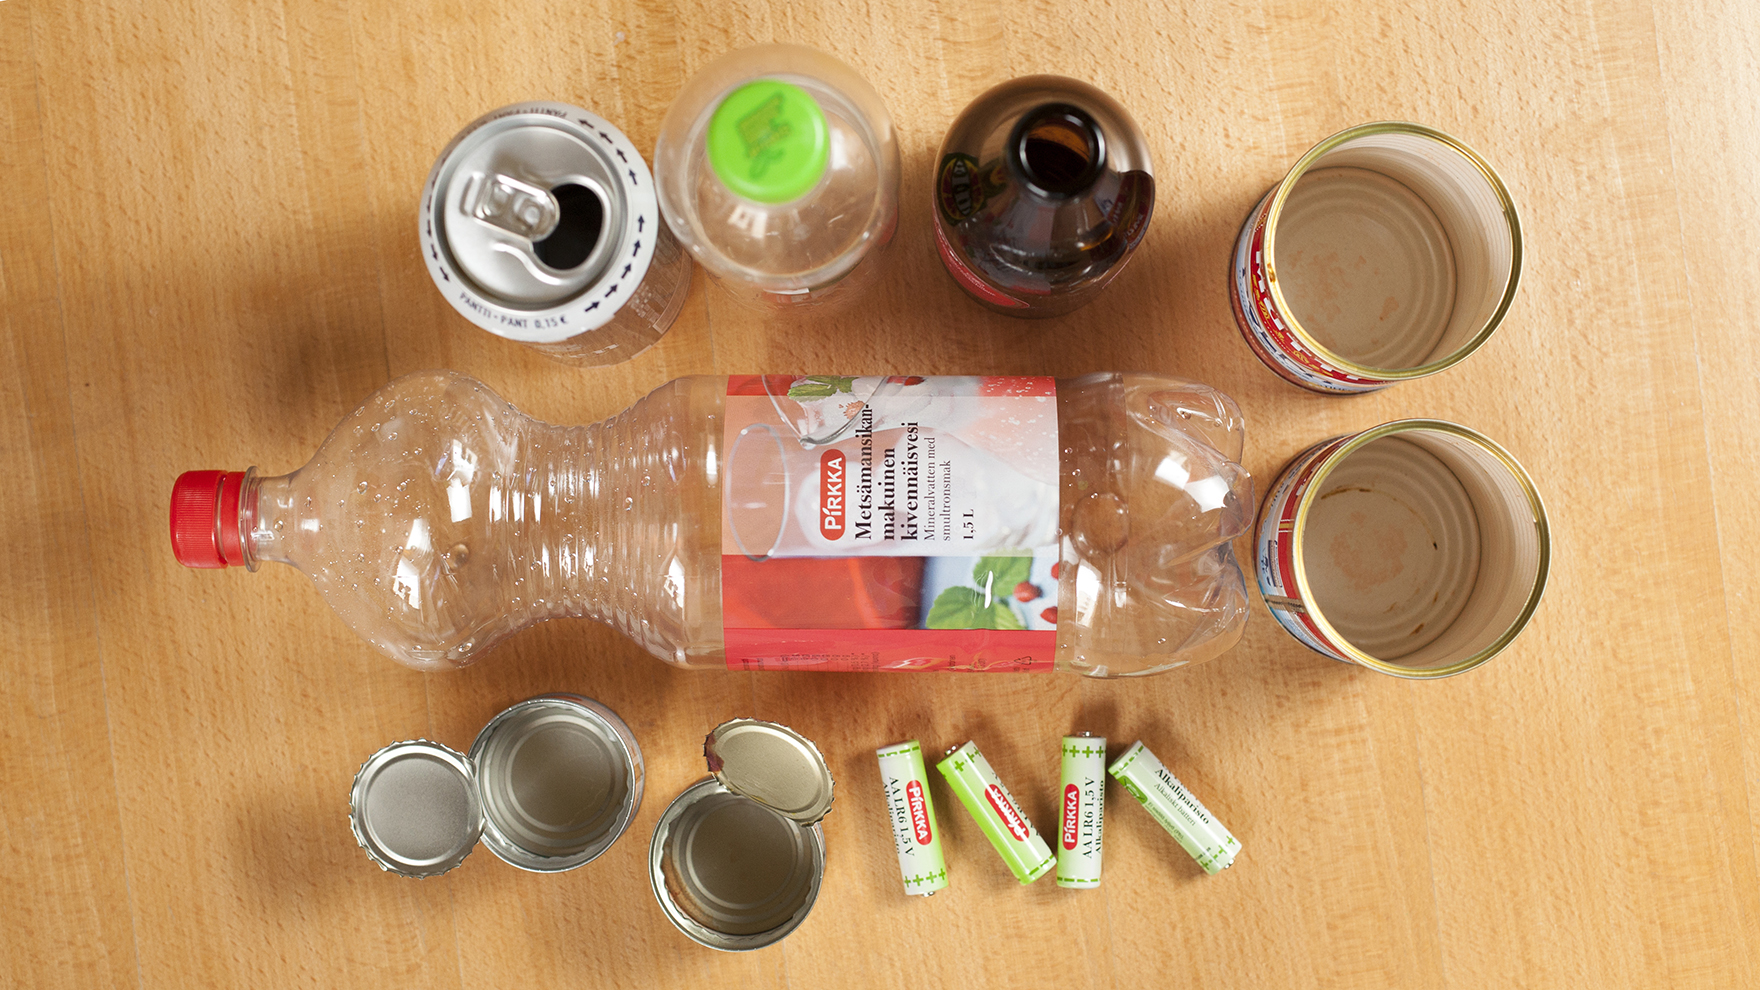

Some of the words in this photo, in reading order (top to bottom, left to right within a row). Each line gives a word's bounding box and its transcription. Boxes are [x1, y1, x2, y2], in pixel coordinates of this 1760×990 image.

[460, 291, 492, 319] PANTTI
[501, 315, 528, 329] PANT
[534, 317, 558, 330] 0,15
[560, 314, 567, 324] €
[924, 437, 936, 459] med
[855, 403, 873, 540] Metsämansikan-
[901, 421, 919, 541] kivennäisvesi
[878, 447, 896, 541] makuinen
[924, 463, 936, 541] Mineralvatten
[939, 459, 951, 541] smultronsmak
[963, 508, 975, 519] L
[963, 521, 977, 540] 1,5
[889, 776, 901, 795] AA
[1084, 777, 1095, 787] V
[1084, 789, 1095, 808] 1,5
[1154, 782, 1178, 809] Alkaliskt
[1177, 804, 1196, 827] batteri
[1155, 768, 1210, 825] Alkaliparisto
[894, 798, 908, 824] LR6
[900, 826, 912, 845] 1,5
[1083, 811, 1094, 838] LR6
[905, 846, 915, 857] V
[1082, 840, 1093, 859] AA
